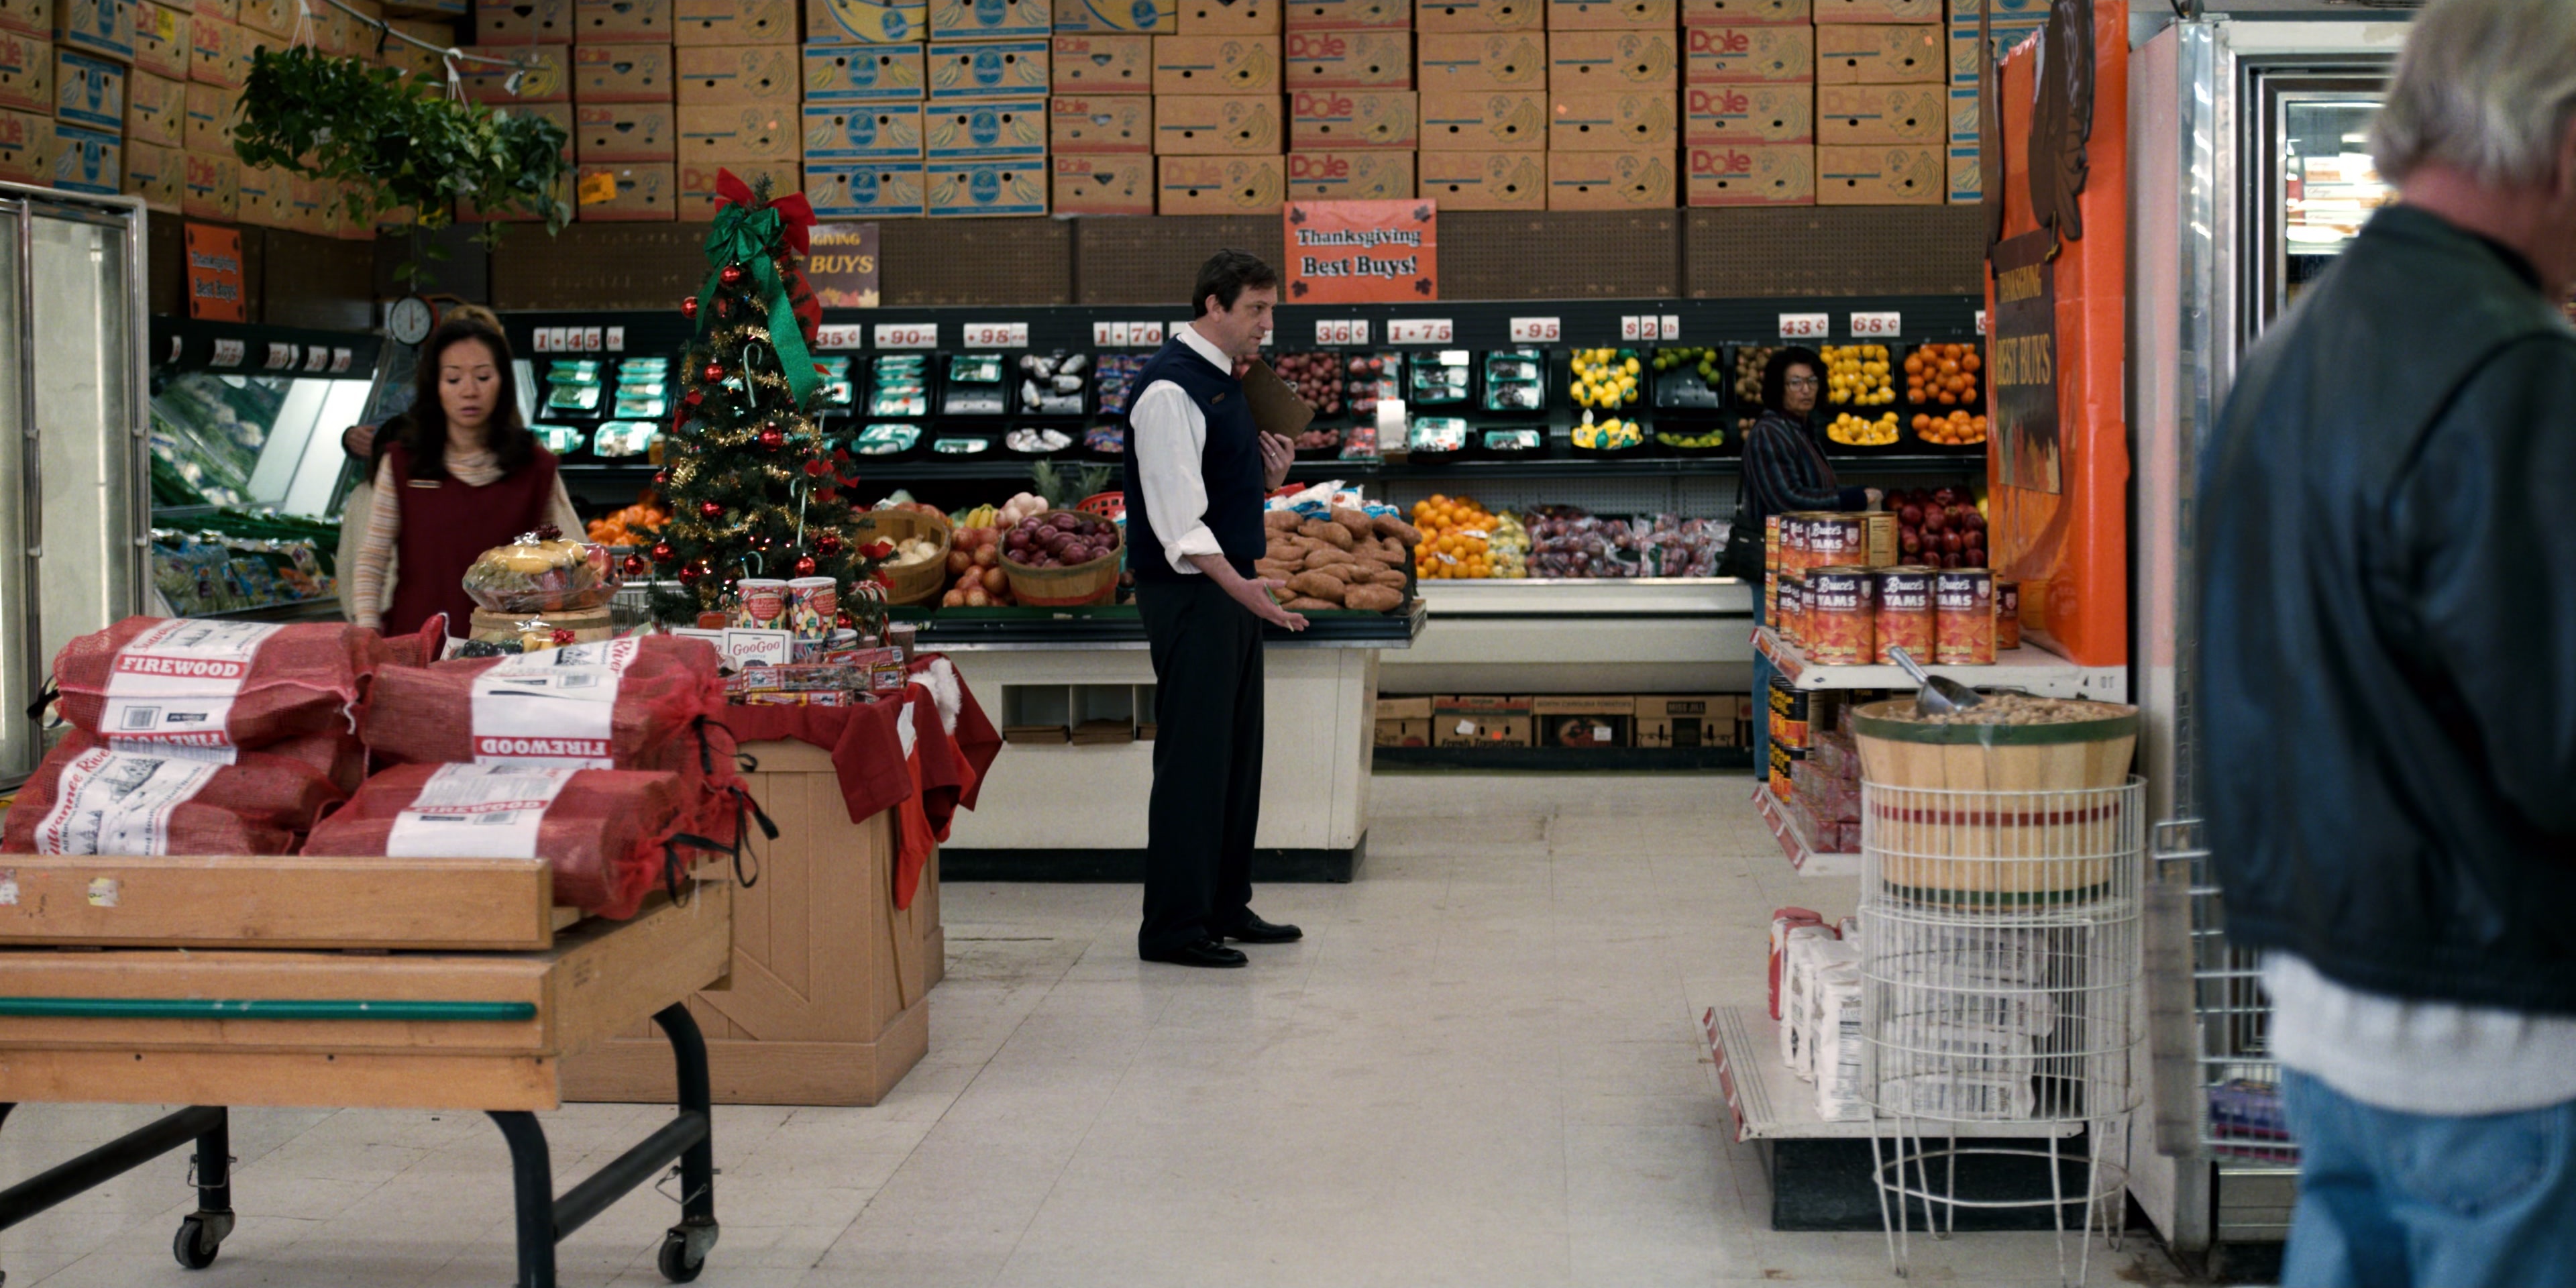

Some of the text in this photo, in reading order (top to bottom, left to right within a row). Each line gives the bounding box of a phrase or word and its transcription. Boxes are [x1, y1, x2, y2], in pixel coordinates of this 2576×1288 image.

[1055, 38, 1089, 53] Dole
[1288, 34, 1346, 59] Dole
[1690, 29, 1748, 54] Dole
[577, 49, 610, 62] Dole
[1054, 99, 1088, 115] Dole
[1295, 93, 1352, 119] Dole
[1689, 89, 1748, 115] Dole
[579, 108, 613, 122] Dole
[1057, 159, 1091, 174] Dole
[1290, 154, 1349, 180] Dole
[1691, 150, 1752, 175] Dole
[683, 168, 716, 191] Do
[810, 232, 862, 246] GIVING
[1296, 228, 1421, 248] Thanksgiving
[809, 255, 874, 274] BUYS
[1300, 255, 1417, 279] Best Buys!
[195, 277, 215, 298] Best
[1625, 322, 1656, 337] $2
[1997, 333, 2051, 386] BEST BUYS
[1811, 539, 1843, 550] YAMS
[1817, 576, 1856, 593] Bruce's
[1884, 576, 1925, 593] Bruce's
[1817, 595, 1857, 607] YAMS
[1883, 594, 1926, 606] YAMS
[609, 639, 633, 674] River
[733, 641, 781, 657] GooGoo
[120, 657, 240, 678] FIREWOOD
[109, 734, 223, 747] FIREW
[481, 739, 606, 755] FIREWOOD
[43, 749, 112, 855] uwannee Rive
[411, 801, 541, 813] FIREWOOD
